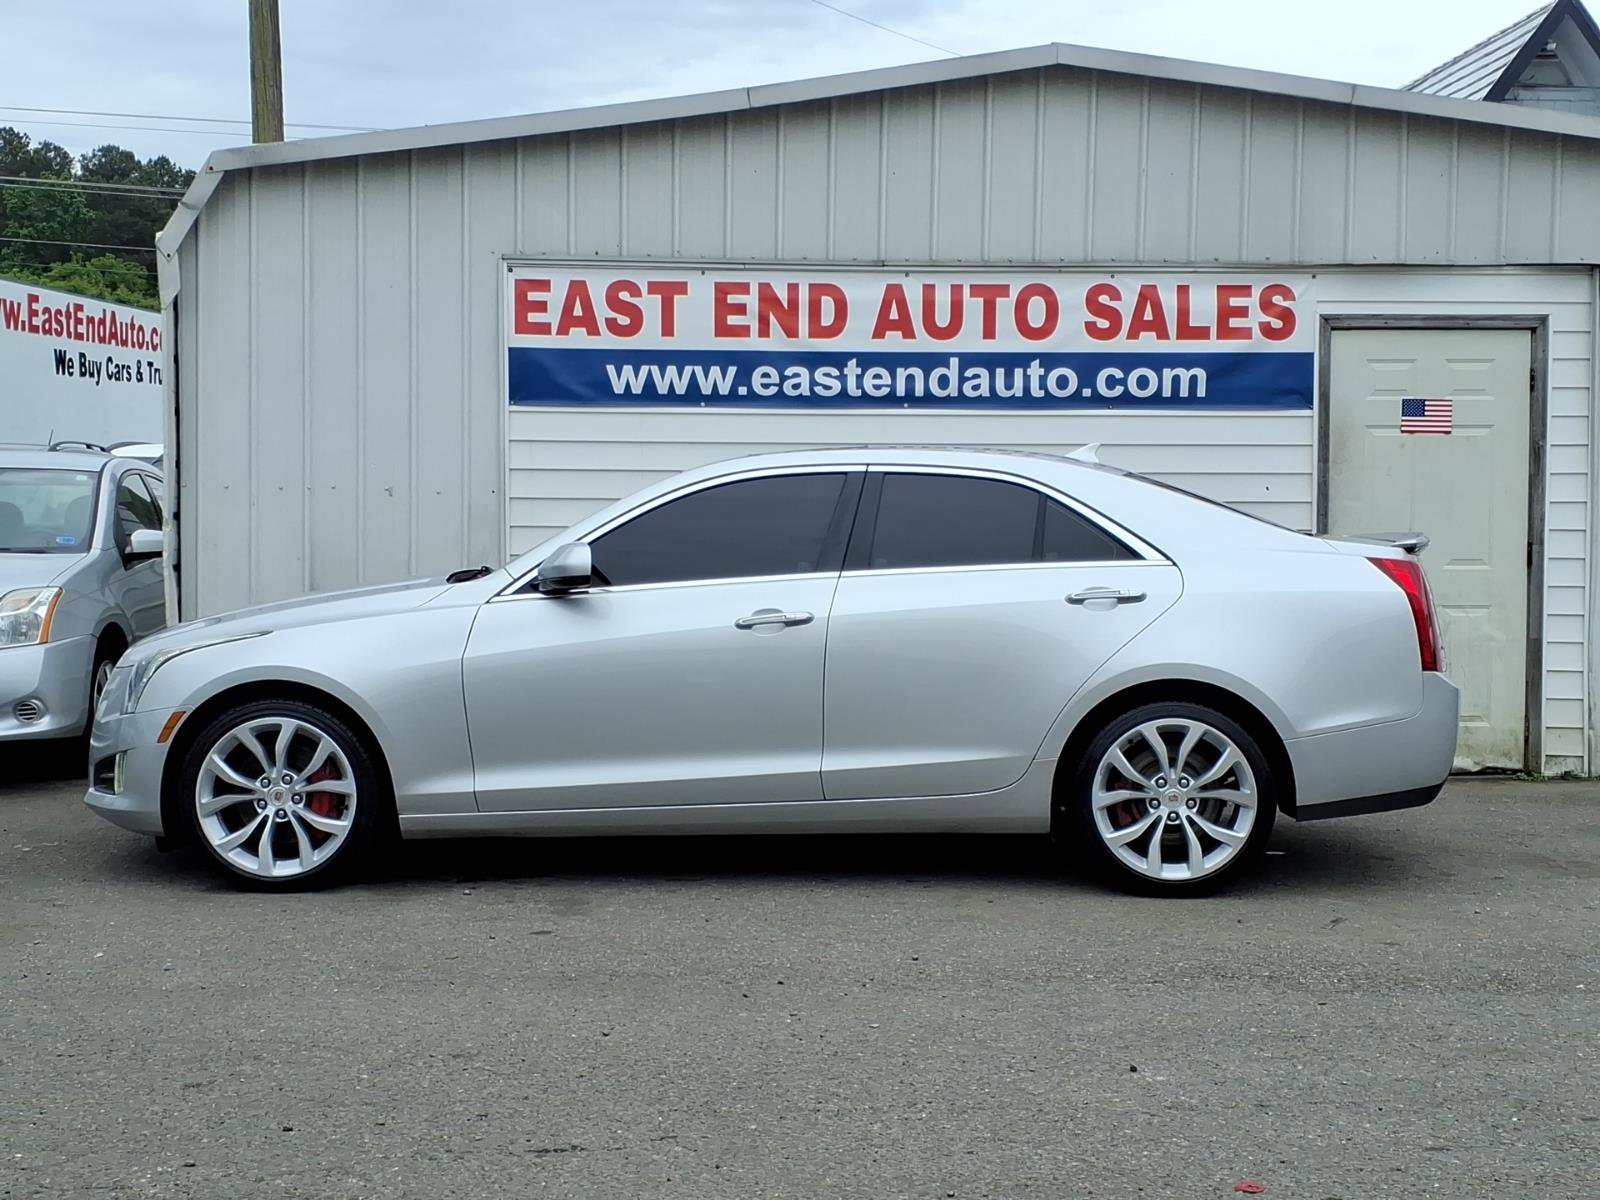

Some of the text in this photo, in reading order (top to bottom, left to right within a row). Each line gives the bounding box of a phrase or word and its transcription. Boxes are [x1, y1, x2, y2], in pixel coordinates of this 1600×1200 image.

[0, 293, 162, 352] w.EastEndAuto.c
[514, 278, 1298, 342] EAST END AUTO SALES
[53, 348, 75, 377] We
[78, 352, 102, 386] Buy
[106, 356, 131, 383] Cars
[135, 359, 144, 383] &
[605, 357, 1207, 398] www.eastendauto.com
